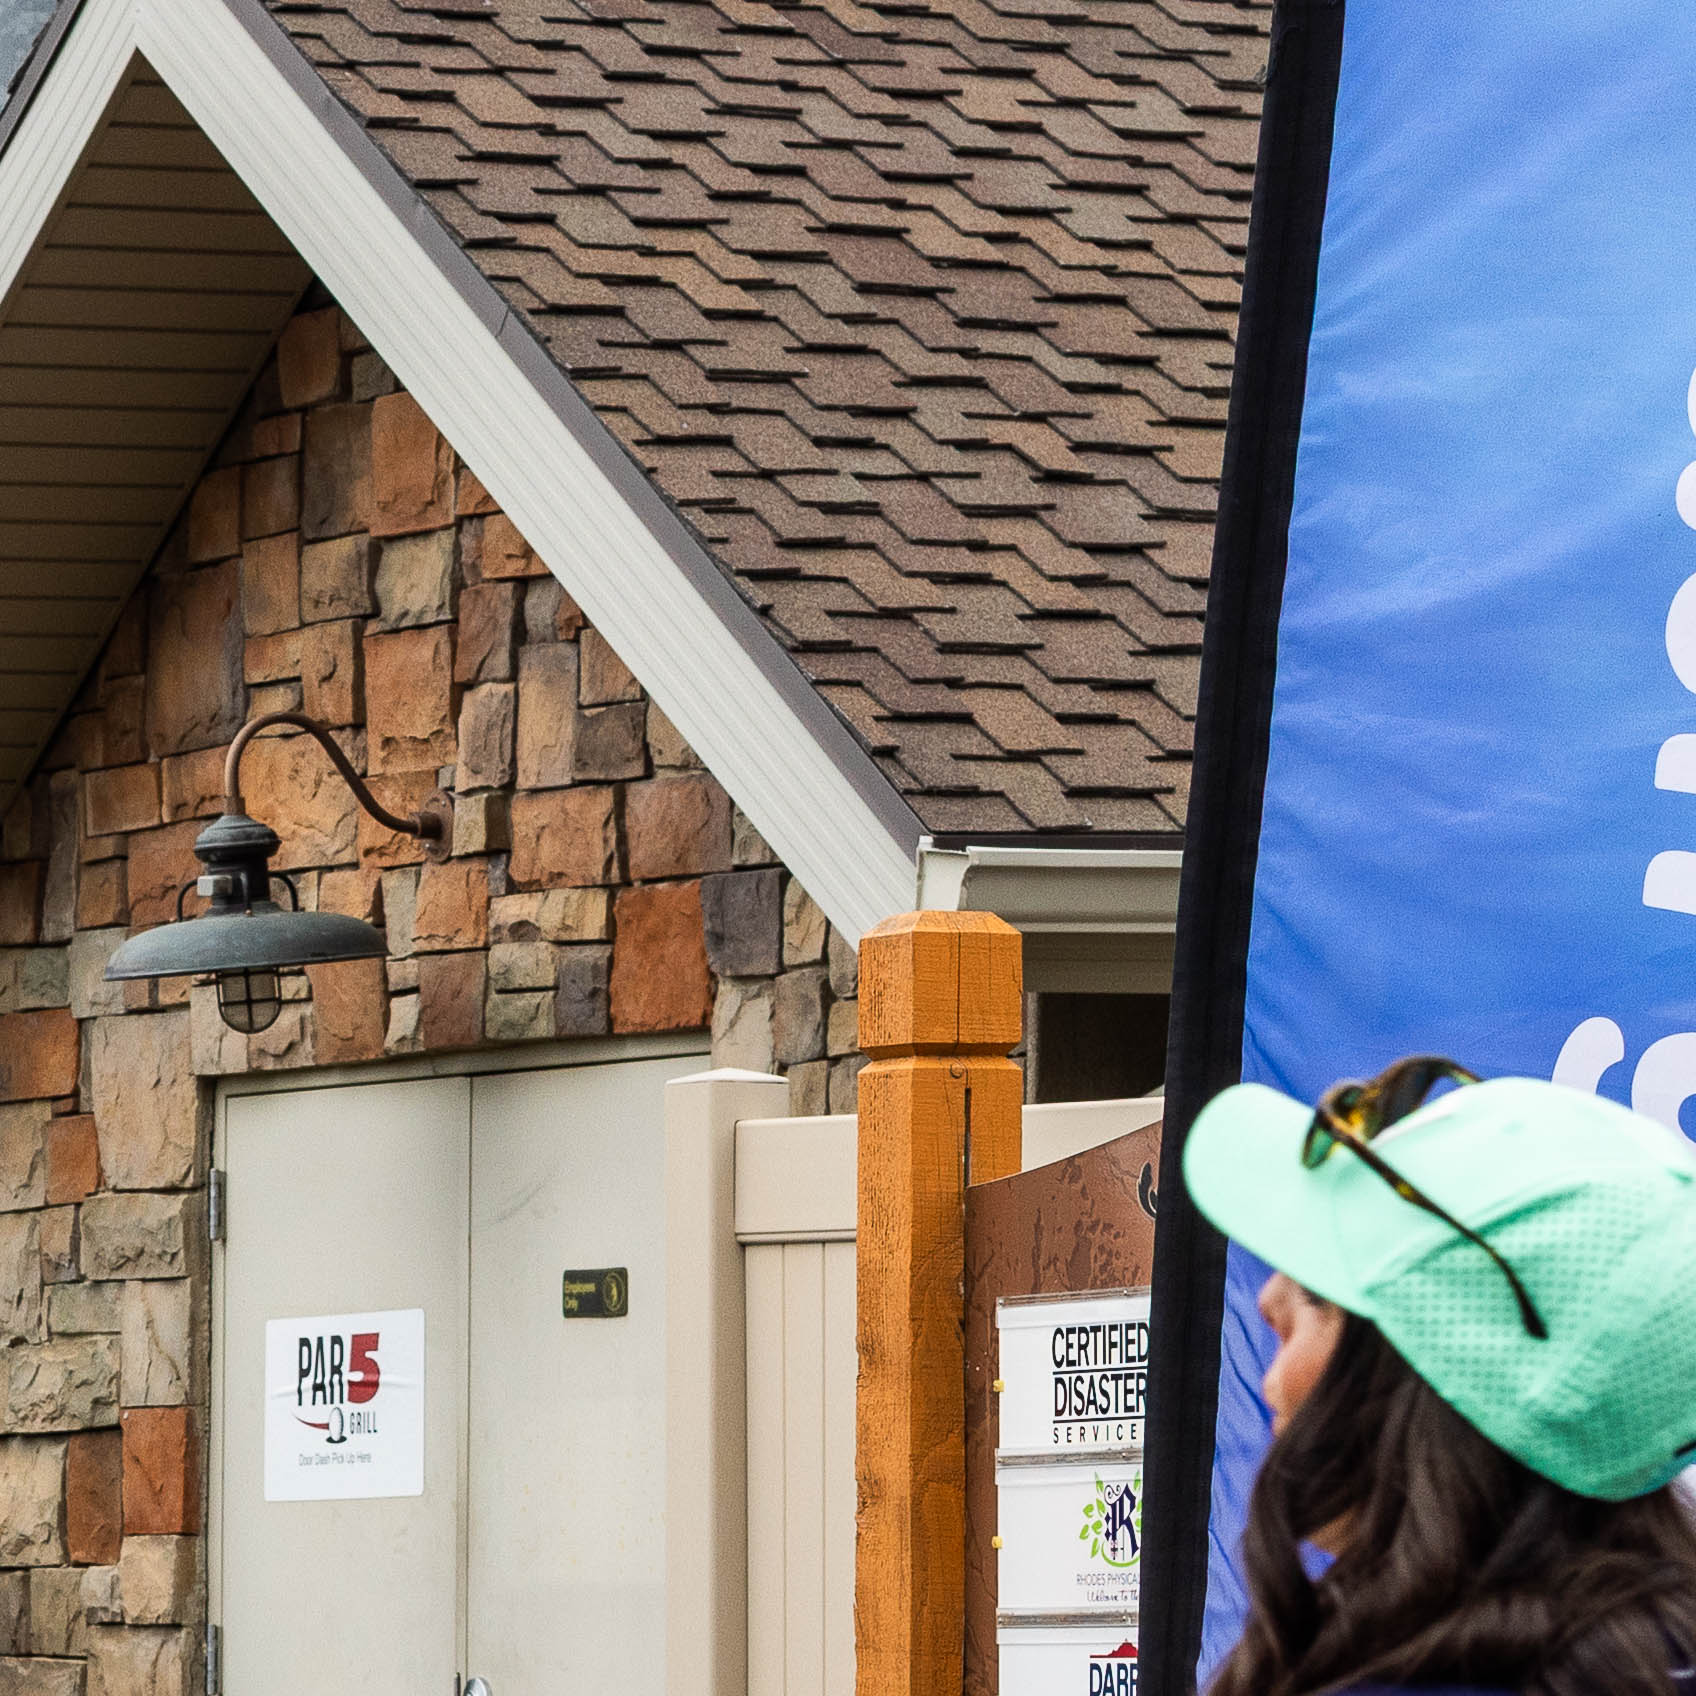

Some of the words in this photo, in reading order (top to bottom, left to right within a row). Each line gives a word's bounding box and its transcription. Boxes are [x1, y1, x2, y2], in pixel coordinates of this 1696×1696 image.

[1052, 1322, 1150, 1368] CERTIFIED
[297, 1335, 344, 1406] PAR
[347, 1332, 380, 1404] 5
[1054, 1372, 1147, 1416] DISASTER
[349, 1411, 378, 1435] GRILL
[1076, 1573, 1106, 1585] RHODES
[1108, 1572, 1140, 1586] PHYSICA
